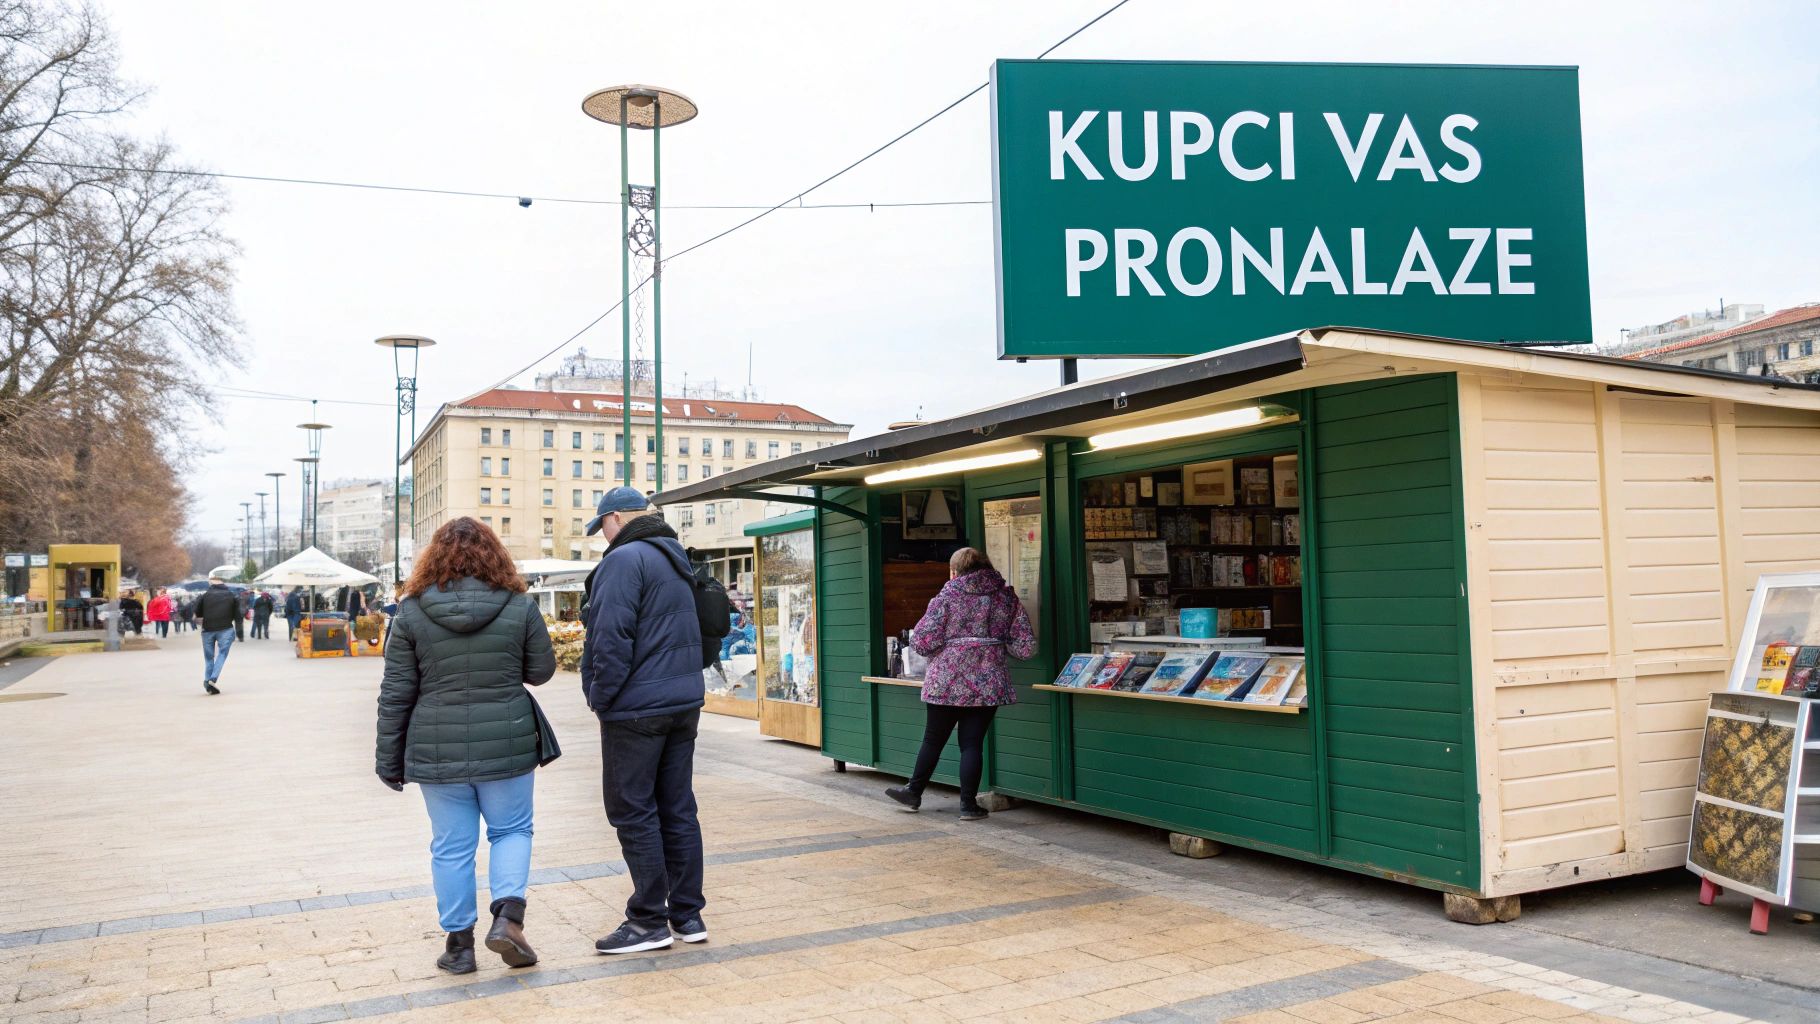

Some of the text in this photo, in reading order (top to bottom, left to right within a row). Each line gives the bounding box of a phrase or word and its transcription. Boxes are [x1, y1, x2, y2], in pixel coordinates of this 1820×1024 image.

[1048, 110, 1482, 184] KUPCI VAS
[1065, 226, 1535, 297] PRONALAZE
